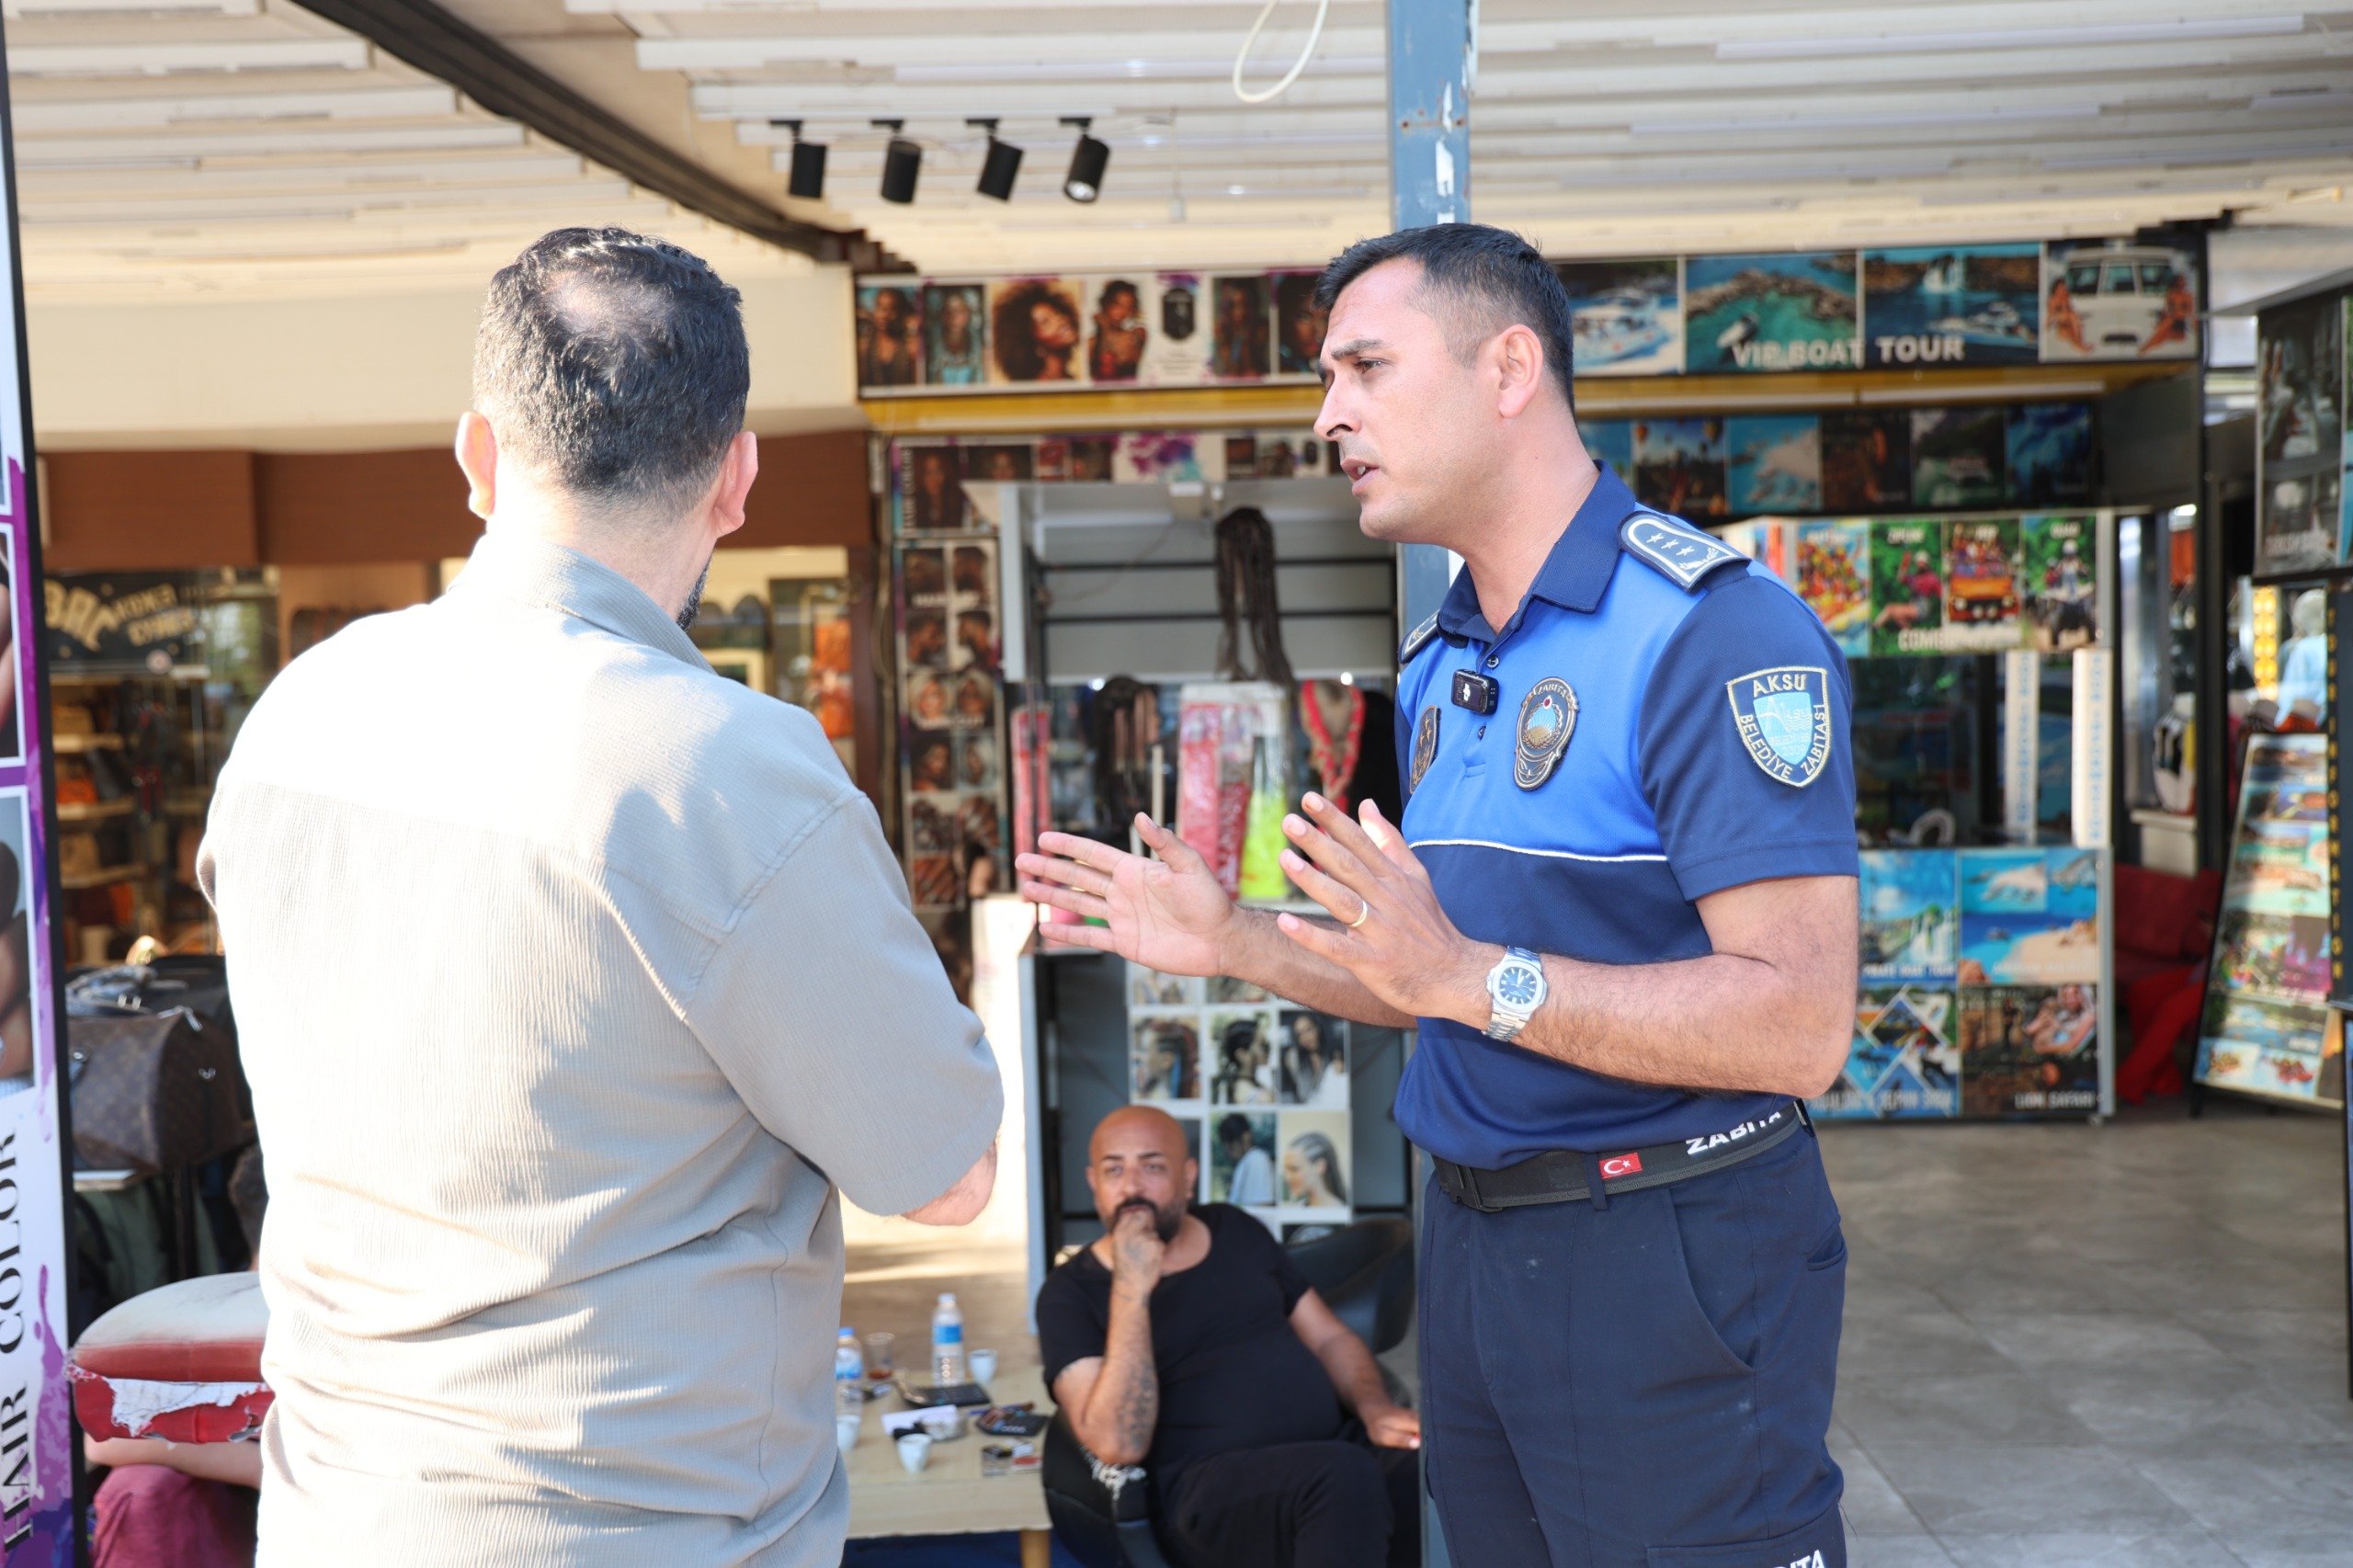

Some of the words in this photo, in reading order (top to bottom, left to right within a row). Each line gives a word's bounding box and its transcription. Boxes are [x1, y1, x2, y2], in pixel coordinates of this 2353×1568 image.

[1733, 340, 1781, 367] VIP
[1788, 338, 1864, 367] BOAT
[1876, 335, 1965, 364] TOUR
[1538, 684, 1566, 698] ZABITA
[1753, 674, 1807, 698] AKSU
[1740, 714, 1792, 778] BELEDİYE
[1801, 704, 1826, 776] ZABITASI
[2328, 716, 2343, 980] INFORMATION
[1, 1381, 34, 1557] HAIR
